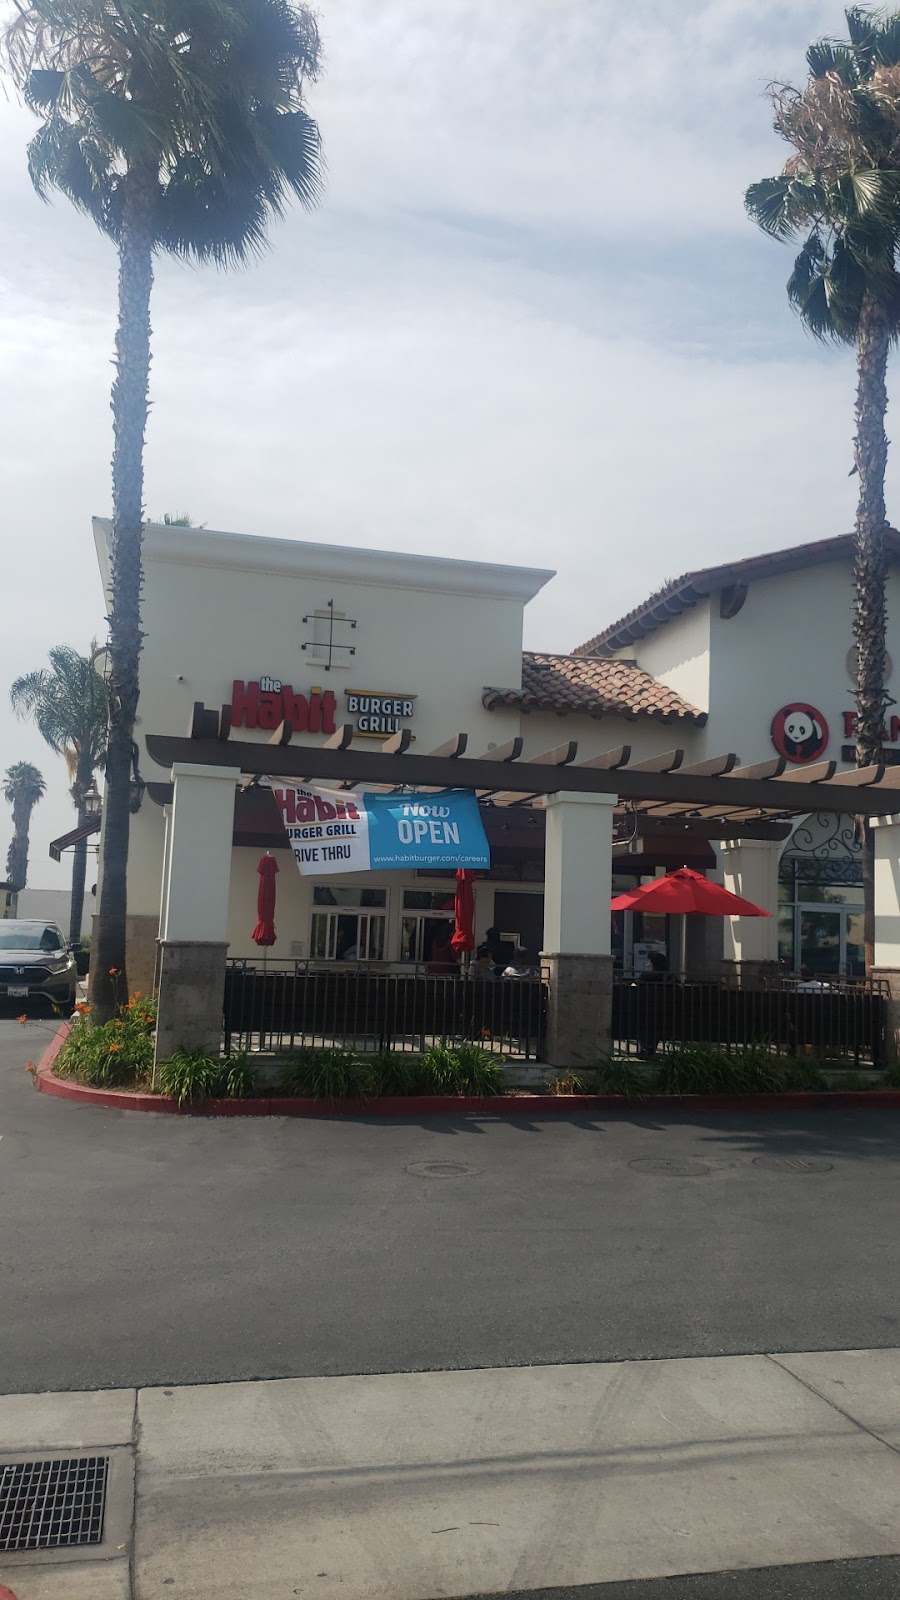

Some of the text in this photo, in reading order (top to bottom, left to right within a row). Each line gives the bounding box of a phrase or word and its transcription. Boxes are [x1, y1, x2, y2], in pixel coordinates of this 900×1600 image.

[260, 676, 282, 693] the
[230, 680, 337, 734] Habit
[348, 696, 413, 716] BURGER
[358, 716, 402, 733] GRILL
[296, 788, 313, 797] the
[274, 788, 361, 823] Habit
[399, 802, 451, 818] Now
[326, 824, 357, 836] GRILL
[398, 819, 460, 844] OPEN
[321, 844, 352, 861] THRU
[373, 854, 488, 864] www.habitburger.com/careers
